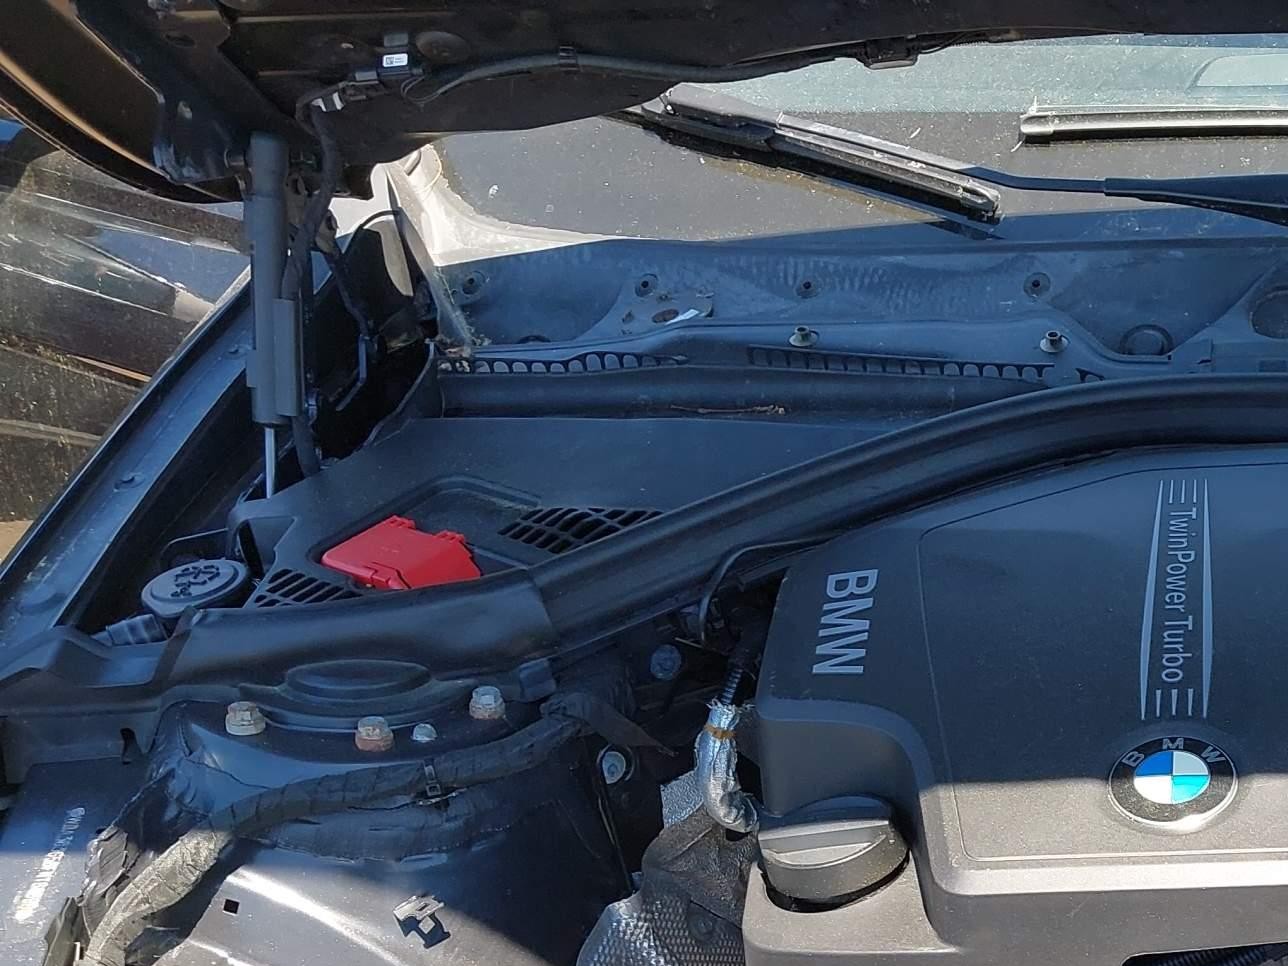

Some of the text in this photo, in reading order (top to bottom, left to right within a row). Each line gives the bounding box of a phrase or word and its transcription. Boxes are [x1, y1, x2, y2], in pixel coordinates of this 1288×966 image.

[812, 568, 879, 674] BMW
[1161, 506, 1198, 682] TwinPower Turbo
[1121, 737, 1227, 768] BMW
